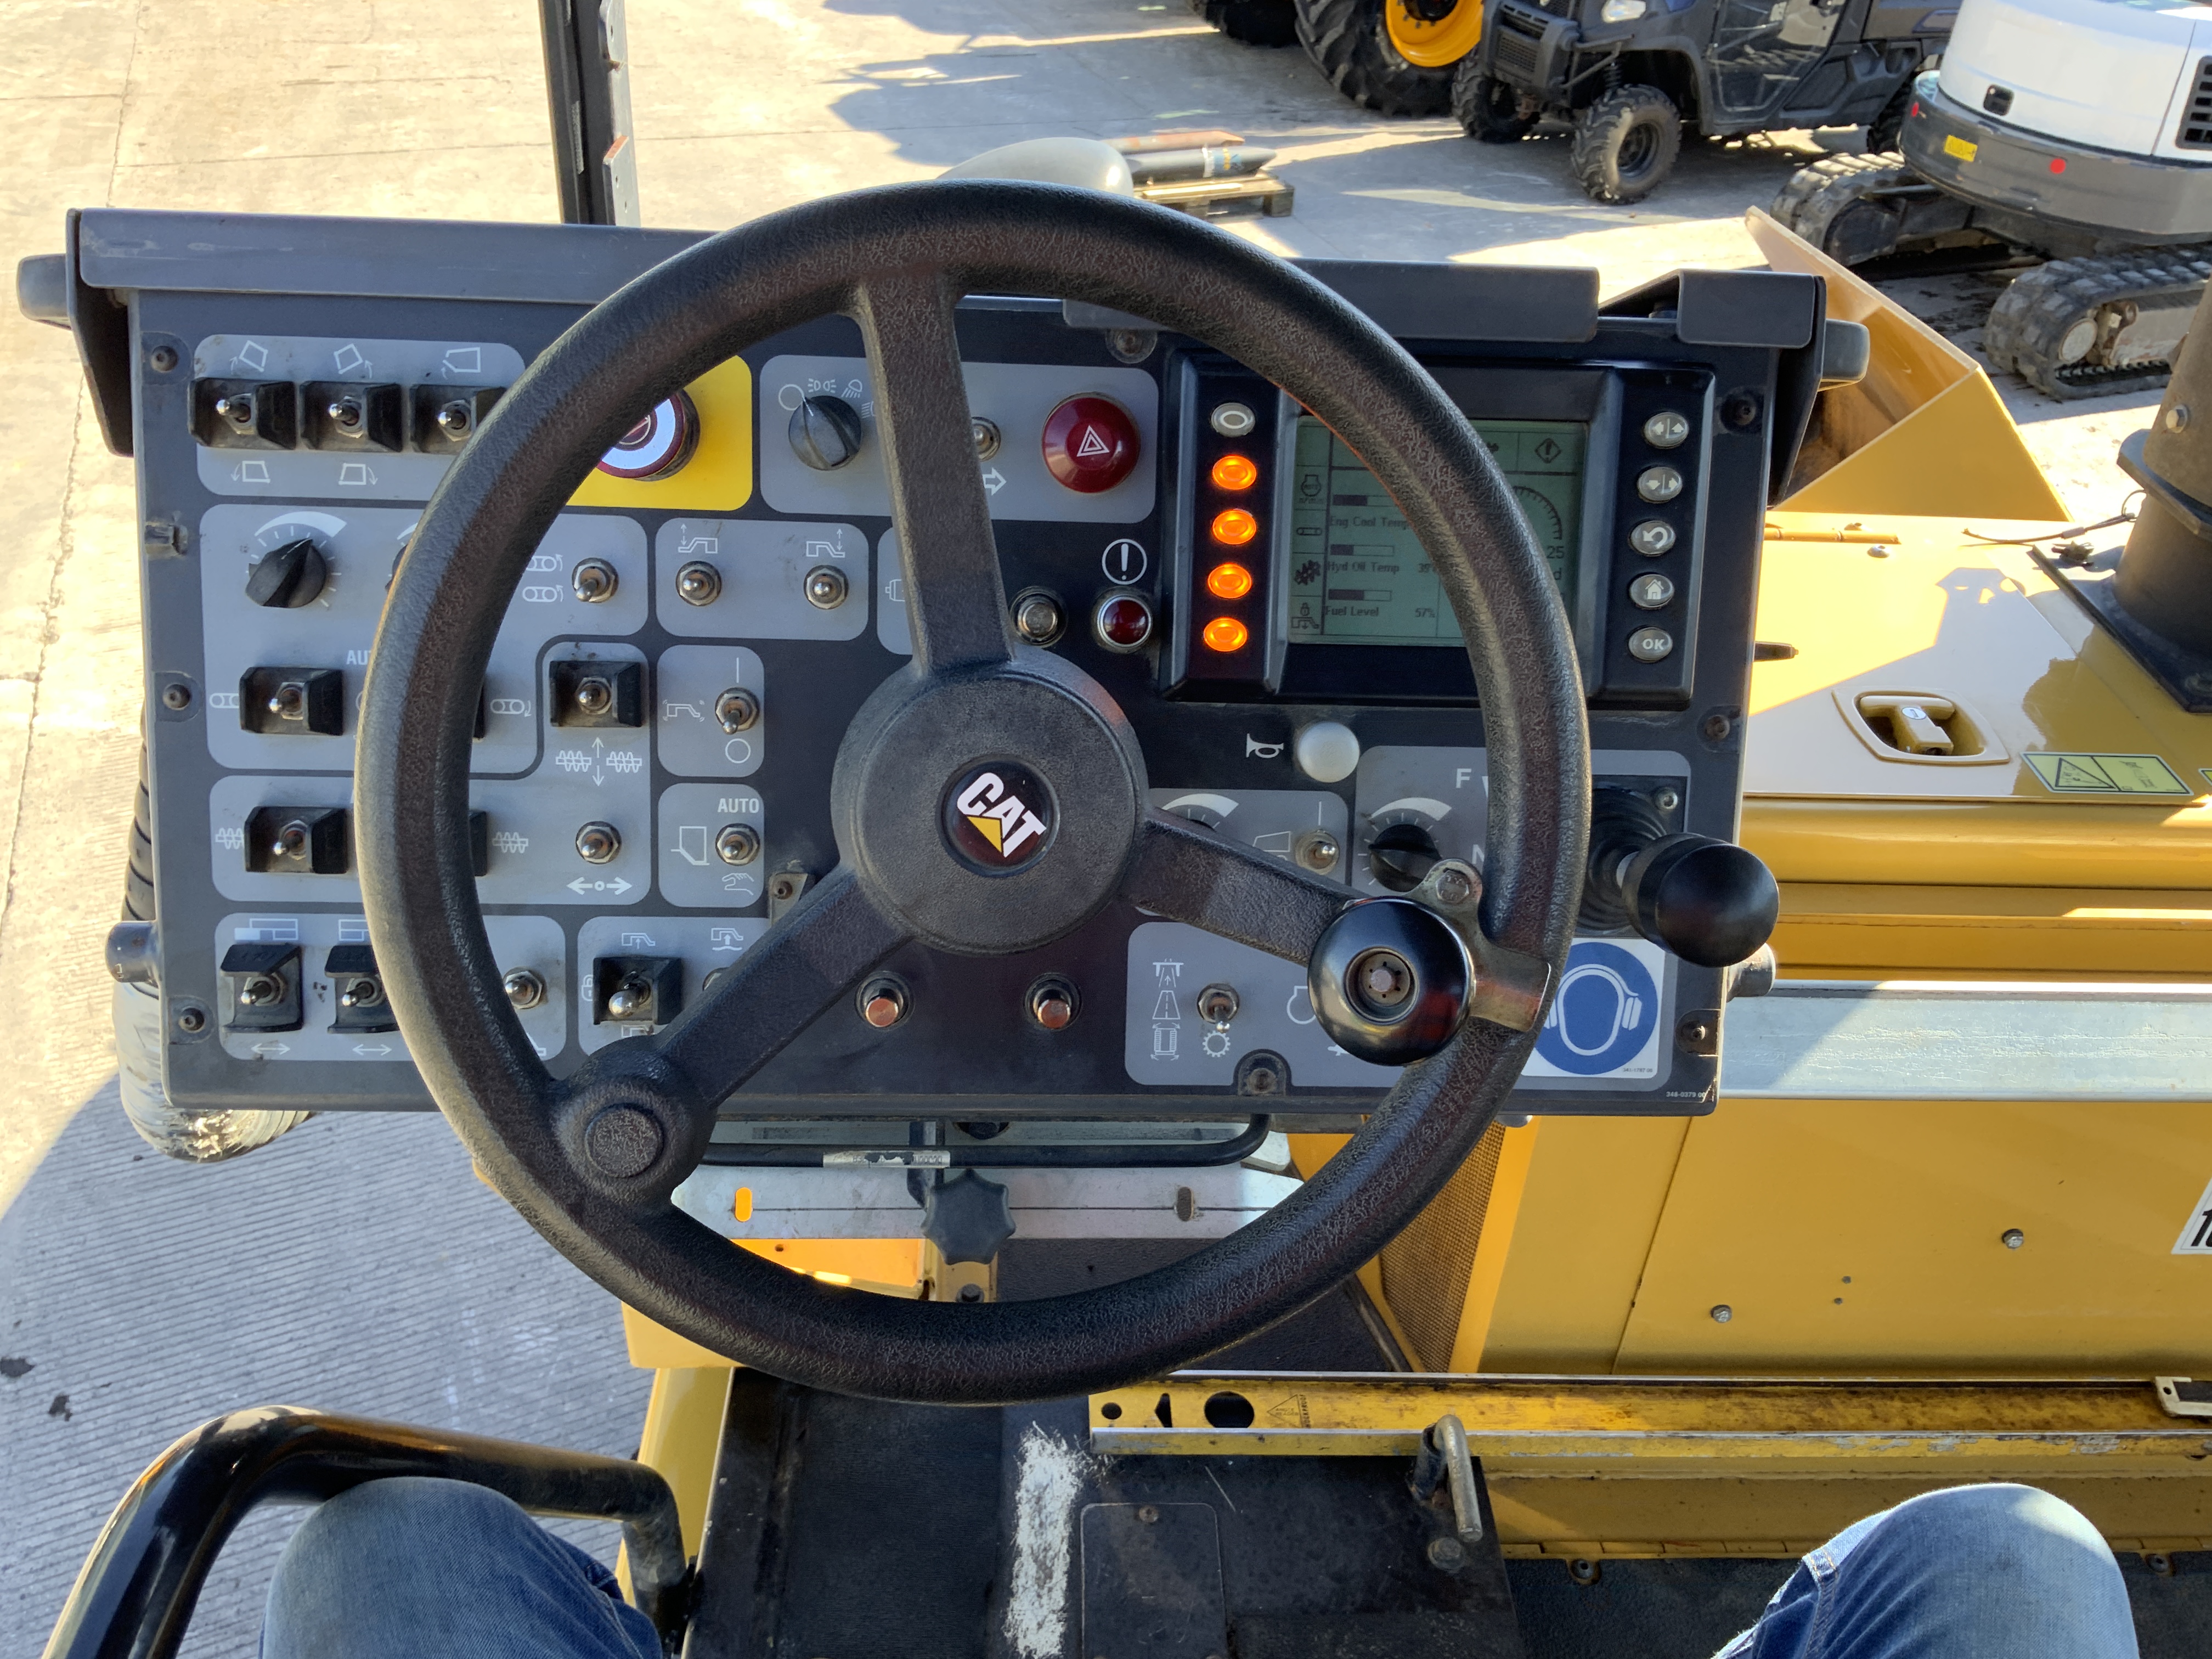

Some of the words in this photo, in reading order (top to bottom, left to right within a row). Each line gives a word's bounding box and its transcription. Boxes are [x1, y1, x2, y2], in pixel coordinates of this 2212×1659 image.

[1330, 516, 1348, 528] Eng
[1353, 516, 1376, 527] Cool
[1327, 561, 1348, 573] Hyd
[1352, 561, 1365, 571] Oil
[1371, 562, 1400, 575] Temp
[1325, 606, 1347, 616] Fuel
[1350, 607, 1379, 617] Level
[1415, 608, 1435, 618] 57%
[1642, 638, 1664, 650] OK
[346, 650, 371, 665] AU
[1455, 768, 1472, 788] F
[717, 798, 759, 813] AUTO
[957, 772, 1047, 858] CAT
